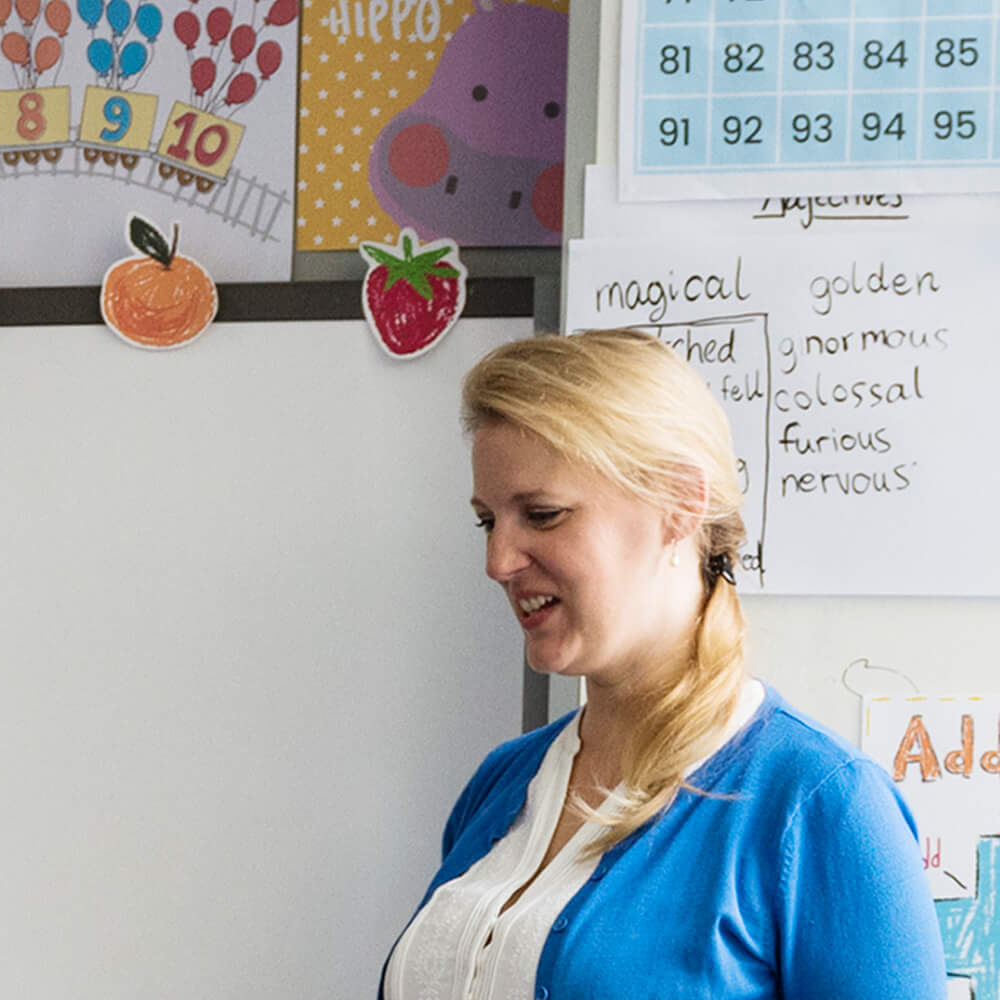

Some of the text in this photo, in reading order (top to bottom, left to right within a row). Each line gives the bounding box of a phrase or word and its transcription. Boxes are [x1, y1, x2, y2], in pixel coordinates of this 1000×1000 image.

[327, 0, 441, 43] HIPPO
[659, 37, 979, 75] 81 82 83 84 85
[16, 92, 47, 140] 8
[100, 95, 132, 143] 9
[166, 112, 229, 167] 10
[659, 110, 976, 146] 91 92 93 94 95
[596, 256, 751, 322] magical
[809, 261, 941, 316] golden
[774, 366, 924, 412] colossal
[778, 422, 892, 455] furious
[782, 463, 911, 497] nervous
